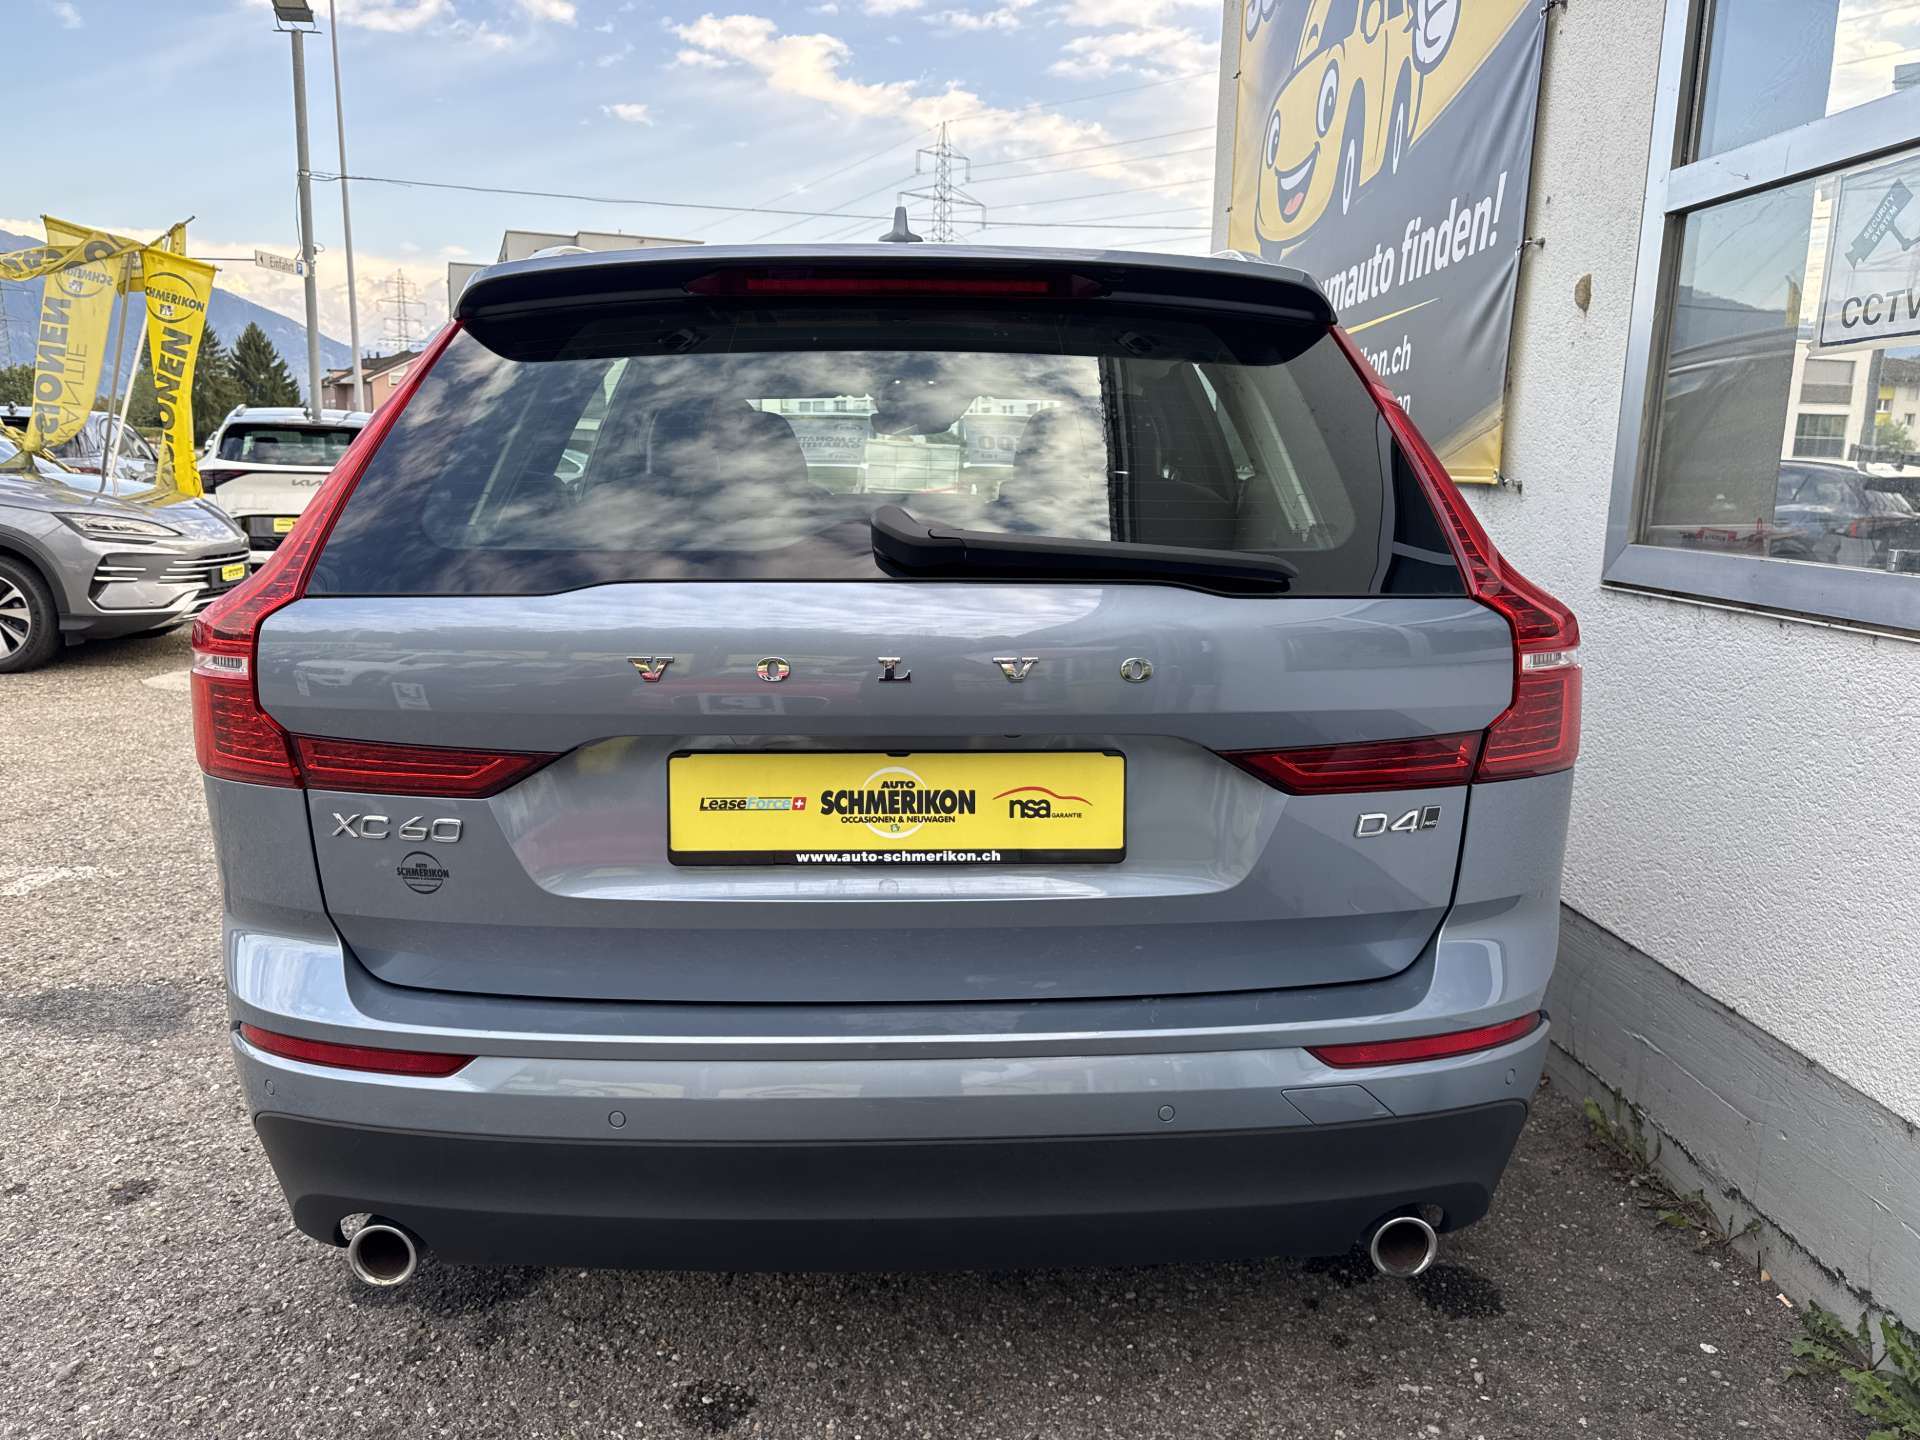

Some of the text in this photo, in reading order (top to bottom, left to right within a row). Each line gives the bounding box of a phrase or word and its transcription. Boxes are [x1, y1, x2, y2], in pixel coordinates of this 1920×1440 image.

[1399, 171, 1508, 287] finden!
[1863, 193, 1896, 240] SECURITY
[1871, 205, 1899, 244] SYSTEM
[145, 286, 205, 312] CHMERIKON
[1841, 288, 1920, 329] CCTV
[626, 656, 1154, 683] VOLVO
[881, 781, 916, 789] AUTO
[700, 797, 791, 811] LeaseForce
[820, 789, 976, 815] SCHMERIKON
[1009, 799, 1051, 818] nsa
[1355, 810, 1418, 838] D4
[796, 850, 1001, 862] www.auto-schmerikon.ch
